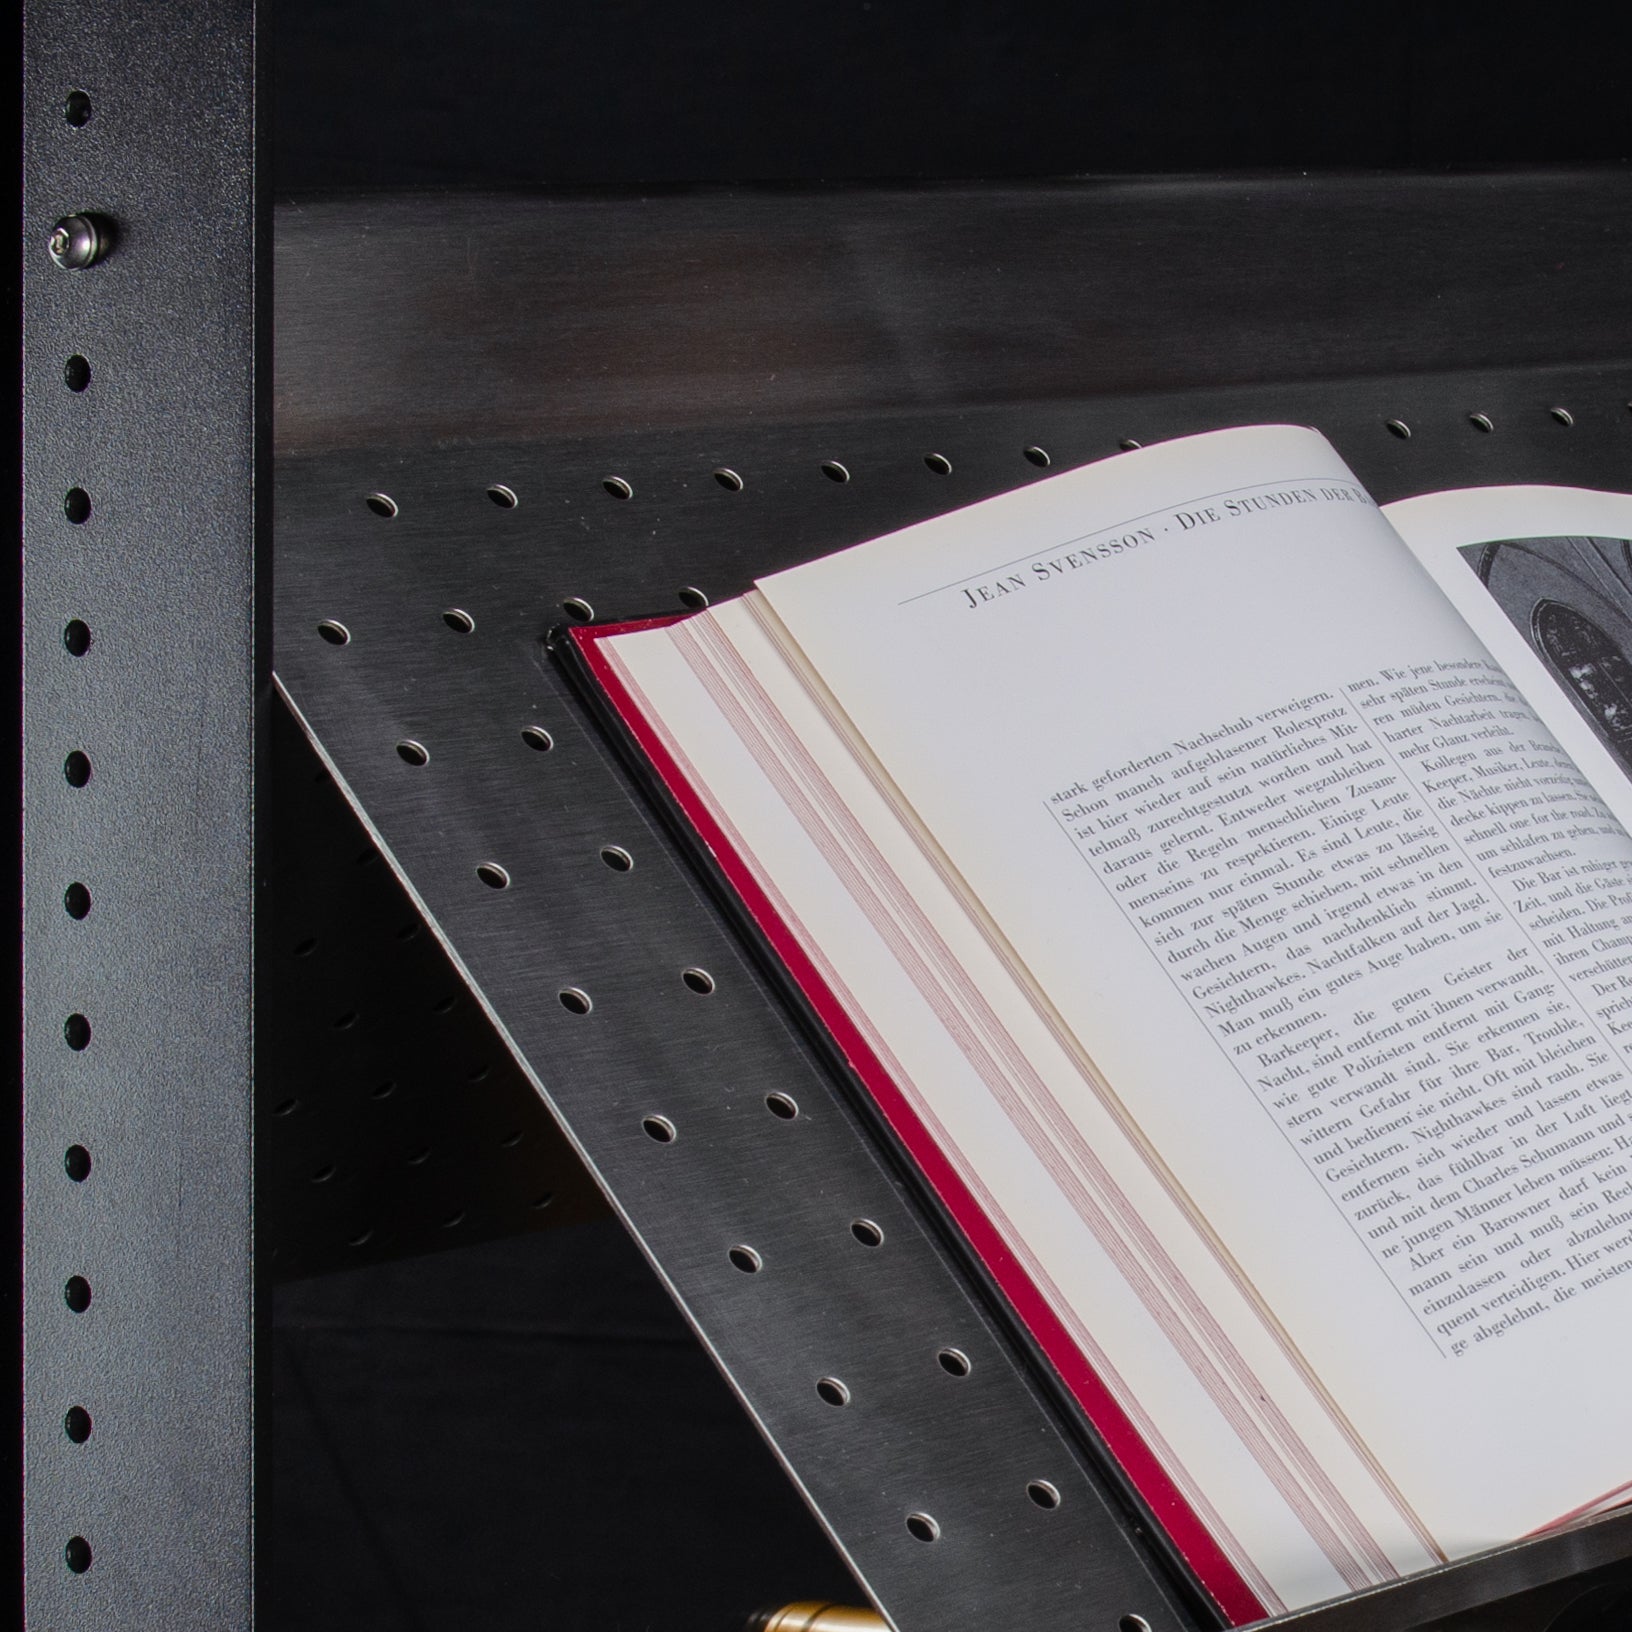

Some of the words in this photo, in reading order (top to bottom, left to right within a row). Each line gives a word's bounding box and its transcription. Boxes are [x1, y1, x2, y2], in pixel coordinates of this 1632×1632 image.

[960, 574, 1028, 609] JEAN
[1031, 526, 1156, 581] SVENSSON
[1174, 507, 1221, 531] DIE
[1225, 489, 1318, 517] STUNDEN
[1050, 781, 1088, 804] stark
[1091, 750, 1173, 791] geforderten
[1172, 716, 1253, 754] Nachschub
[1255, 692, 1333, 722] verweigern.
[1061, 790, 1109, 822] Schon
[1115, 774, 1165, 801] manch
[1171, 735, 1268, 779] aufgeblasener
[1271, 707, 1347, 739] Rolexprotz
[1088, 827, 1141, 856] telmaß
[1147, 784, 1253, 833] zurechtgestutzt
[1258, 763, 1310, 787] worden
[1315, 747, 1344, 766] und
[1345, 740, 1372, 754] hat
[1419, 752, 1478, 773] Kollegen
[1103, 849, 1152, 874] daraus
[1159, 824, 1213, 855] gelernt.
[1217, 793, 1287, 826] Entweder
[1293, 758, 1385, 796] wegzubleiben
[1128, 877, 1194, 910] menseins
[1200, 867, 1219, 880] zu
[1225, 829, 1316, 870] respektieren.
[1318, 808, 1367, 830] Einige
[1370, 792, 1410, 810] Leute
[1475, 849, 1499, 862] um
[1499, 833, 1550, 854] schlafen
[1487, 849, 1576, 879] festzuwachsen.
[1167, 937, 1211, 963] durch
[1214, 928, 1237, 943] die
[1237, 907, 1288, 932] Menge
[1291, 880, 1358, 911] schieben,
[1359, 866, 1385, 882] mit
[1387, 843, 1450, 871] schnellen
[1510, 877, 1538, 893] Die
[1535, 871, 1564, 885] Bar
[1561, 866, 1580, 878] ist
[1512, 896, 1548, 914] Zeit,
[1547, 885, 1574, 903] und
[1575, 881, 1594, 895] die
[1192, 961, 1276, 999] Gesichtern,
[1286, 944, 1311, 960] das
[1321, 898, 1417, 945] nachdenklich
[1426, 877, 1477, 901] stimmt.
[1203, 972, 1306, 1018] Nighthawkes.
[1305, 931, 1397, 974] Nachtfalken
[1399, 915, 1424, 935] auf
[1427, 908, 1450, 923] der
[1451, 892, 1490, 915] Jagd.
[1256, 1028, 1339, 1067] Barkeeper,
[1353, 1010, 1375, 1025] die
[1391, 987, 1431, 1013] guten
[1443, 961, 1493, 985] Geister
[1507, 947, 1528, 961] der
[1272, 1092, 1299, 1108] wie
[1307, 1075, 1336, 1098] gute
[1342, 1041, 1416, 1077] Polizisten
[1422, 1013, 1479, 1043] entfernt
[1484, 1000, 1509, 1016] mit
[1513, 984, 1554, 1003] Gang-
[1300, 1118, 1353, 1145] wittern
[1359, 1090, 1411, 1118] Gefahr
[1418, 1076, 1442, 1092] für
[1448, 1060, 1480, 1078] ihre
[1485, 1045, 1520, 1062] Bar,
[1523, 1017, 1584, 1045] Trouble,
[1325, 1143, 1409, 1182] Gesichtern.
[1411, 1099, 1506, 1143] Nighthawkes
[1511, 1077, 1542, 1099] sind
[1546, 1062, 1584, 1084] rauh.
[1585, 1051, 1609, 1067] Sie
[1367, 1215, 1398, 1239] und
[1400, 1205, 1427, 1224] mit
[1430, 1191, 1461, 1210] dem
[1462, 1164, 1519, 1193] Charles
[1519, 1130, 1595, 1168] Schumann
[1596, 1113, 1626, 1134] und
[1409, 1247, 1444, 1270] Aber
[1452, 1234, 1476, 1249] ein
[1479, 1198, 1551, 1236] Barowner
[1558, 1177, 1589, 1200] darf
[1592, 1164, 1627, 1183] kein
[1423, 1270, 1506, 1315] einzulassen
[1520, 1247, 1551, 1268] oder
[1450, 1339, 1468, 1357] ge
[1473, 1301, 1549, 1342] abgelehnt,
[1553, 1286, 1576, 1302] die
